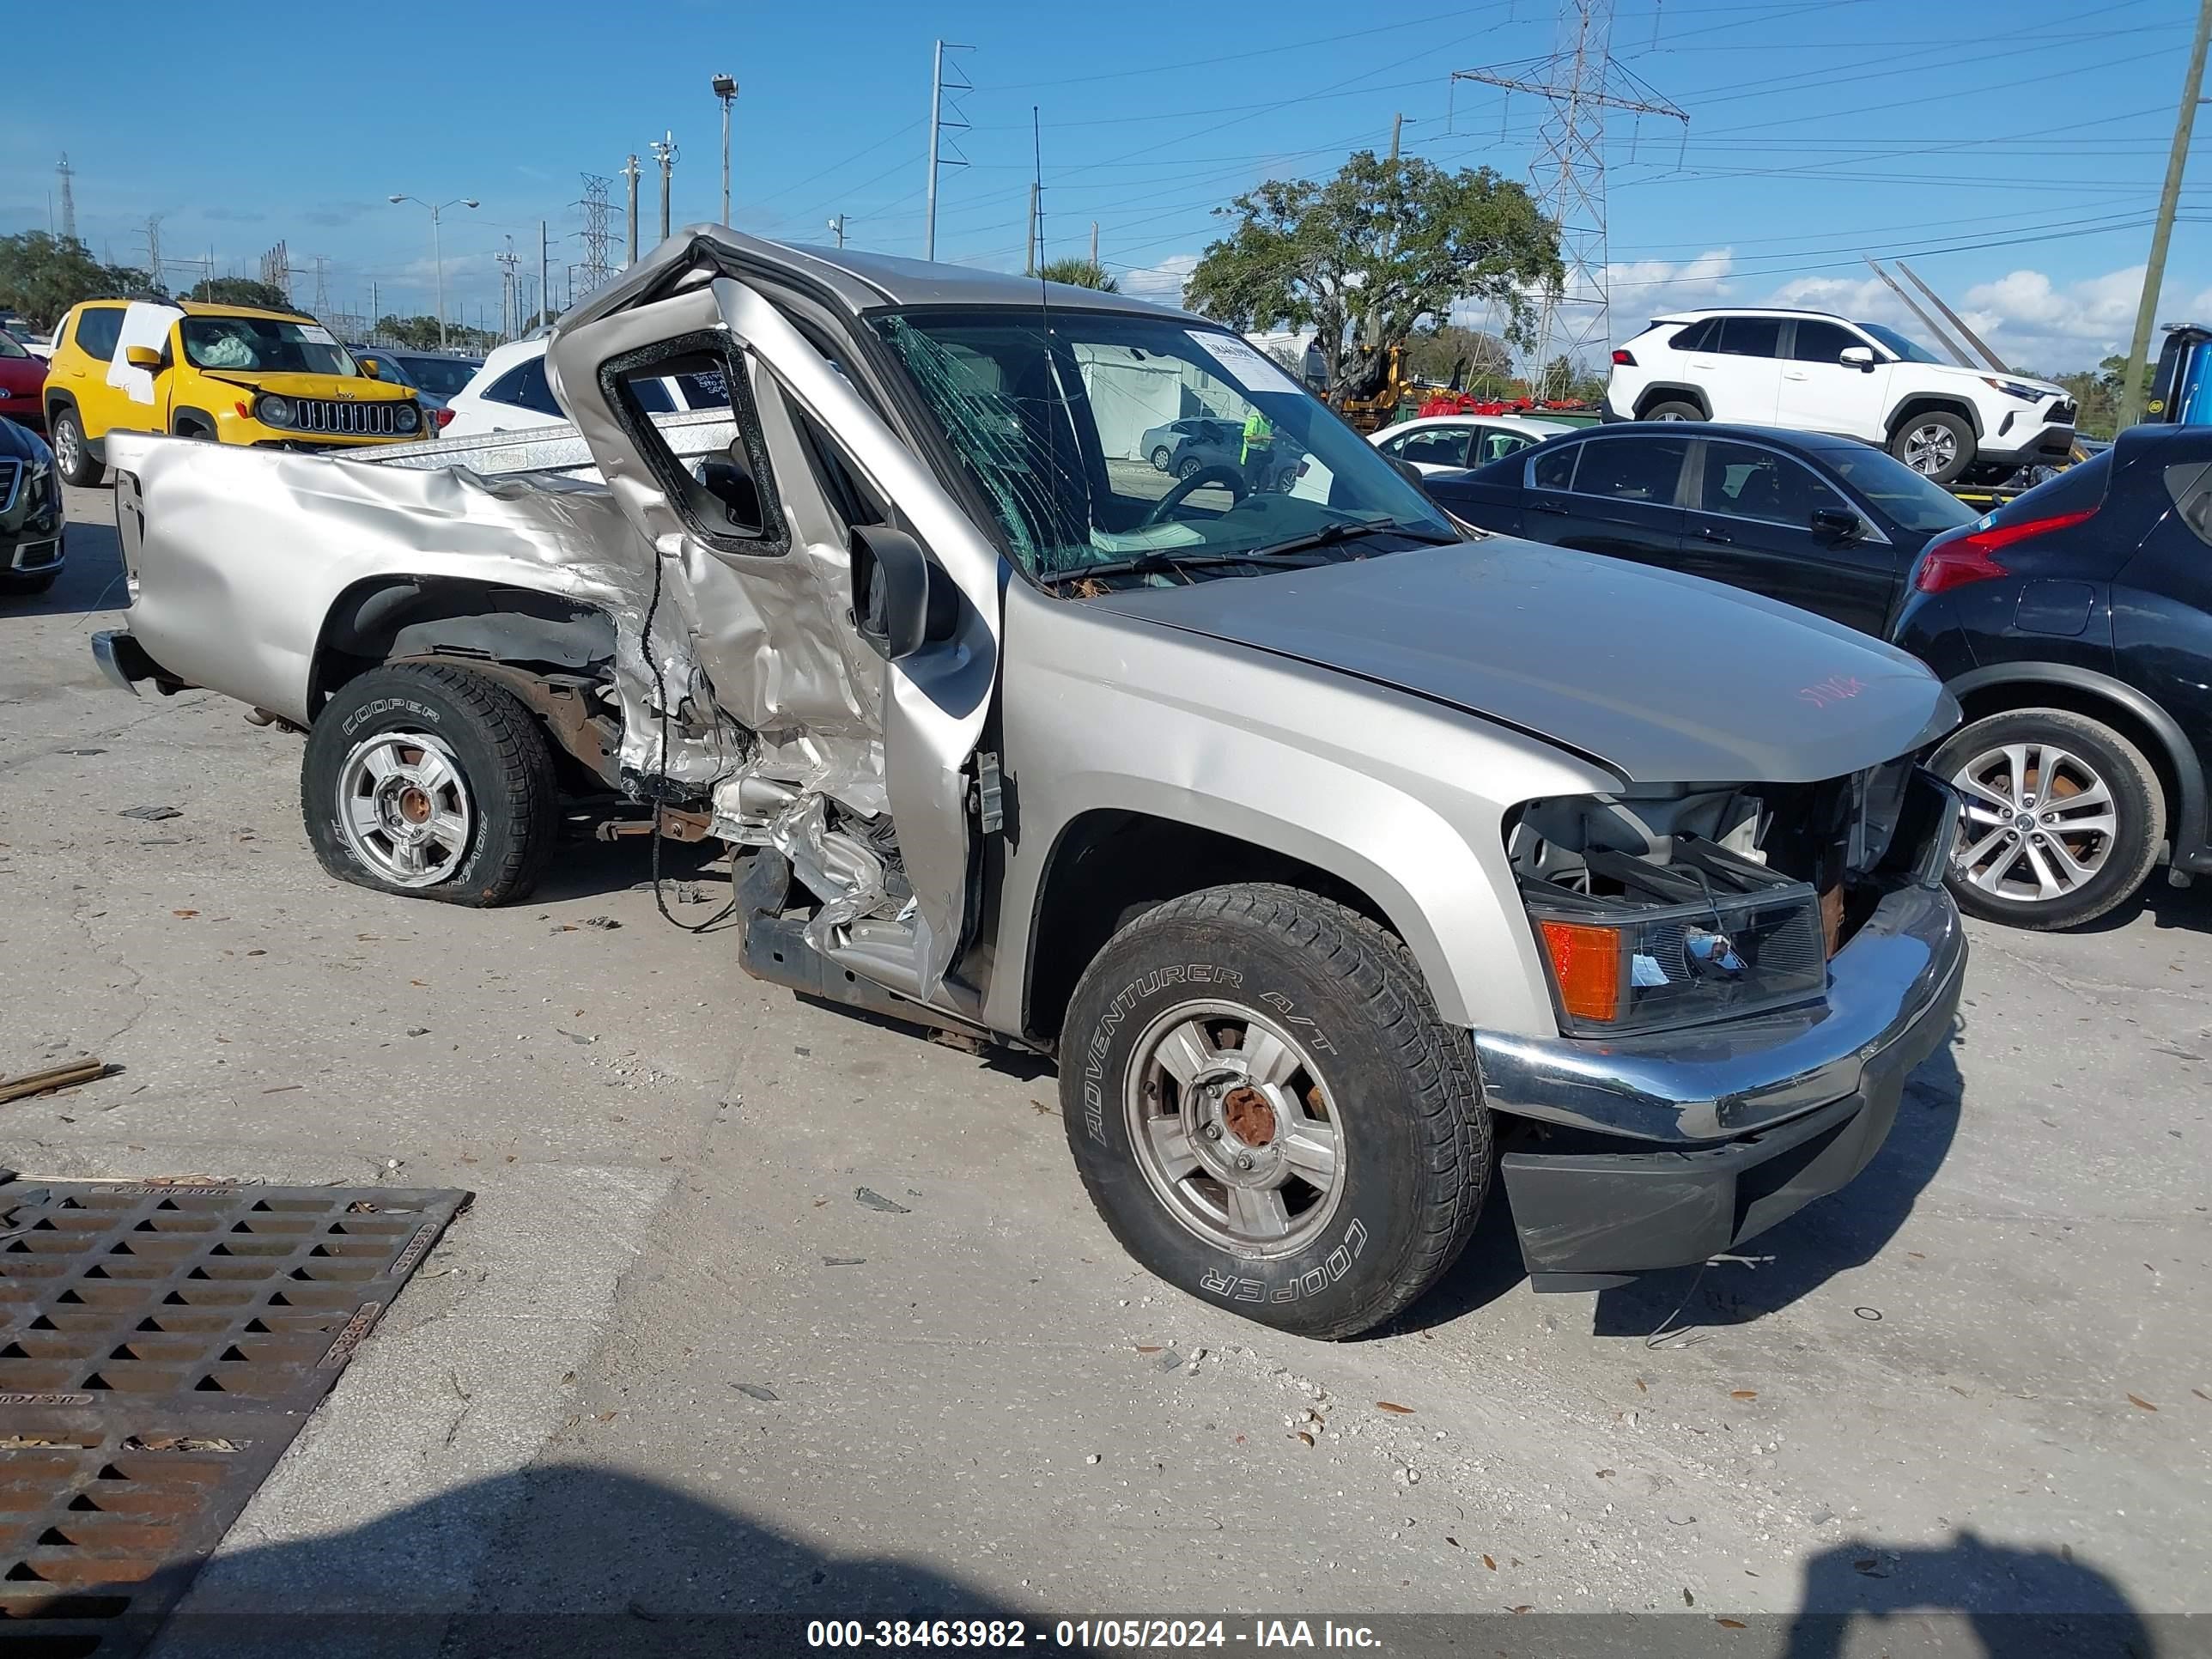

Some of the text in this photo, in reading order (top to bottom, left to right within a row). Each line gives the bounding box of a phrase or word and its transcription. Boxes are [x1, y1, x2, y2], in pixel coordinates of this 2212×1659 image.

[342, 698, 441, 735] COOPER
[1084, 963, 1339, 1148] ADVENTURER A/T
[1200, 1218, 1368, 1304] COOPER
